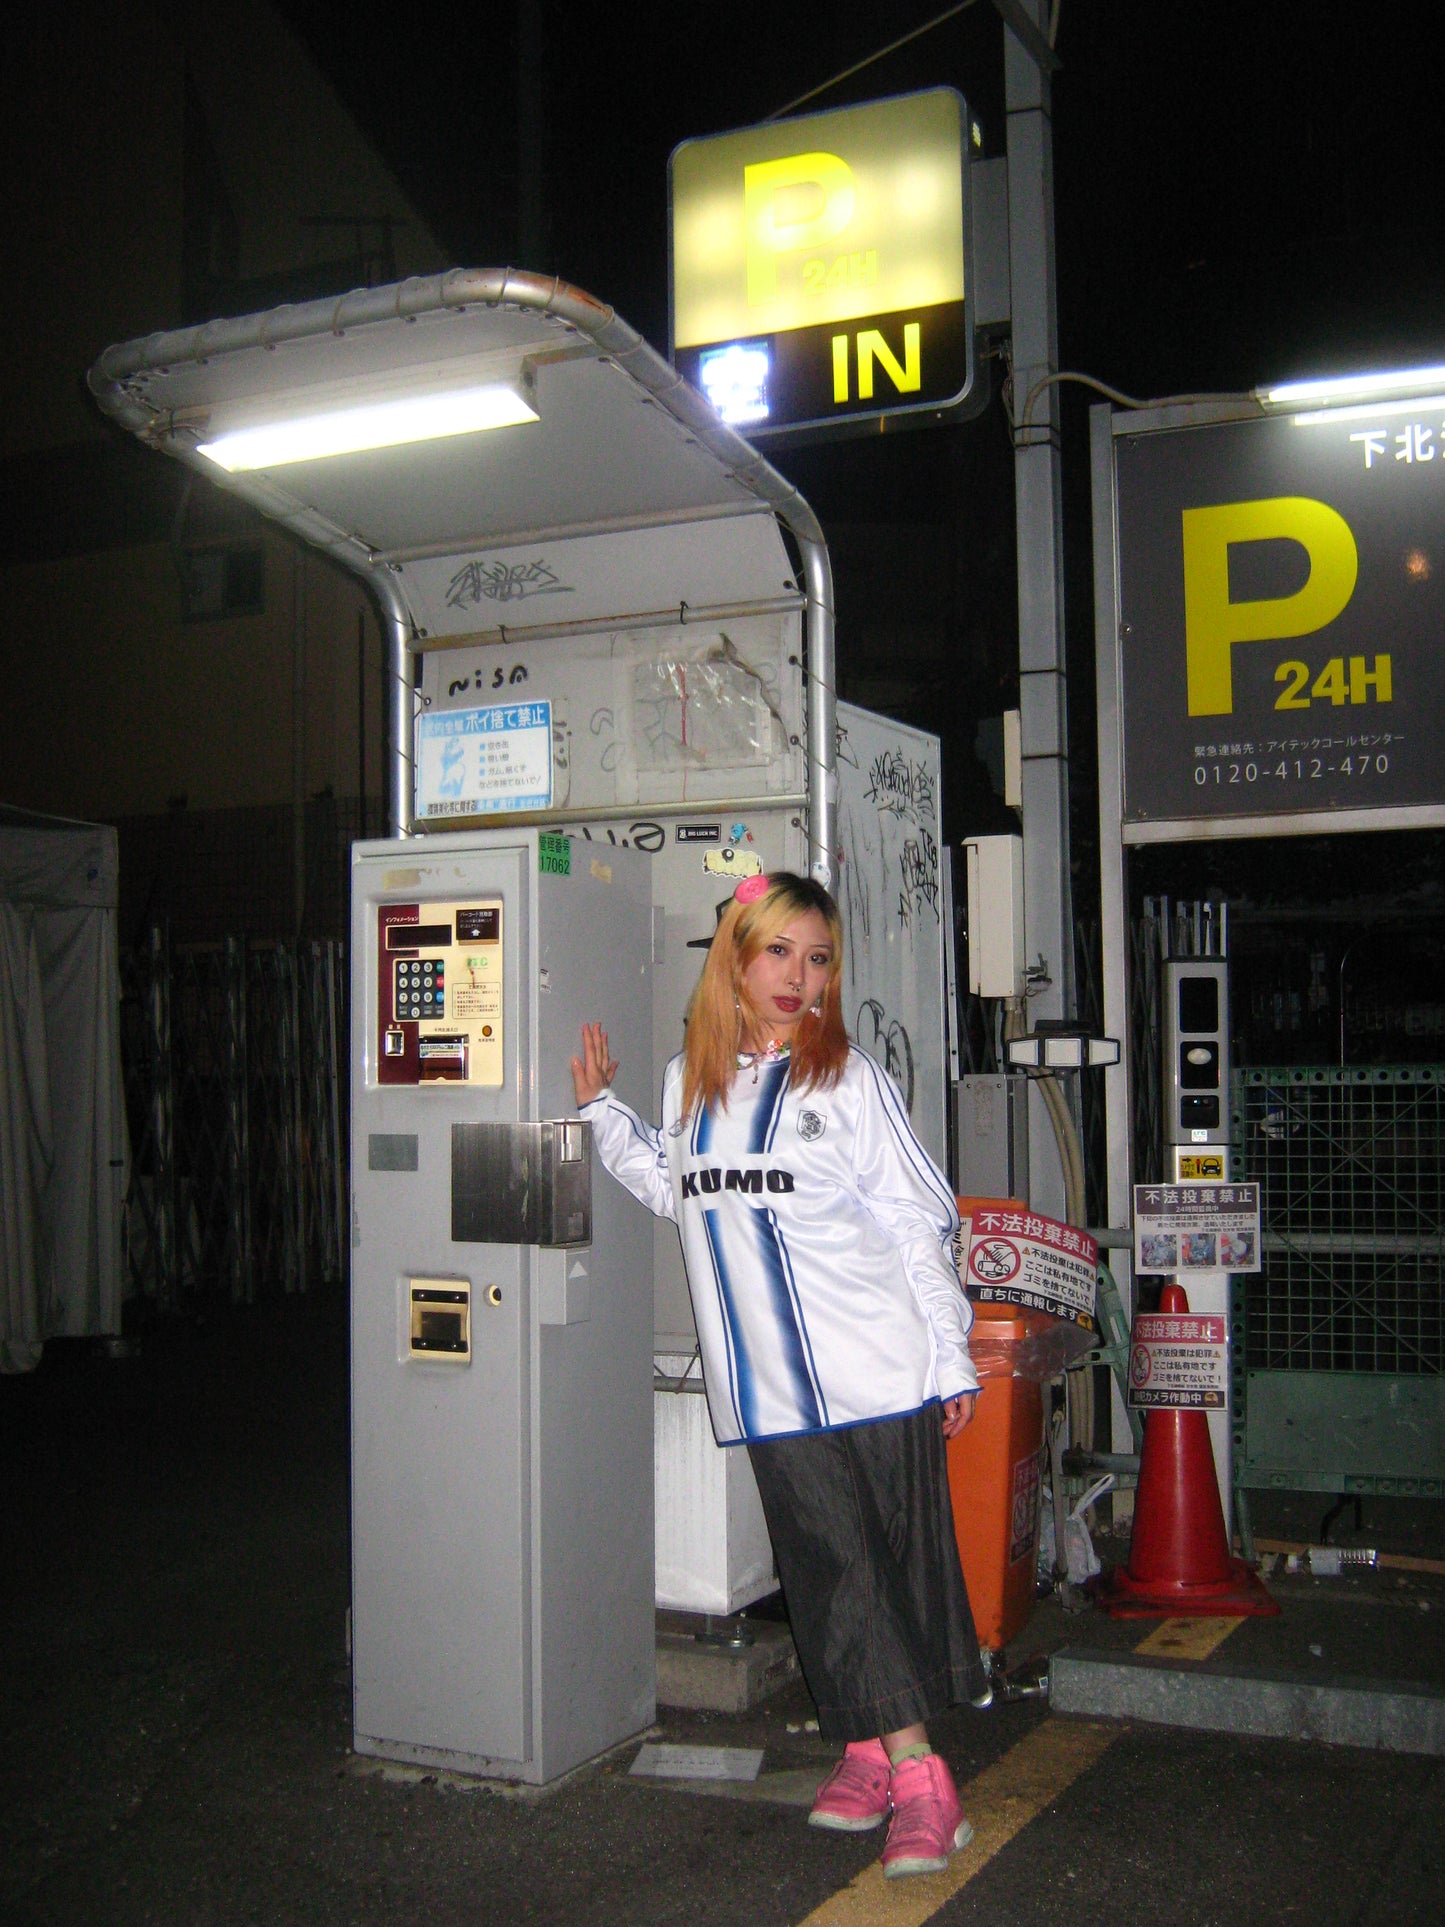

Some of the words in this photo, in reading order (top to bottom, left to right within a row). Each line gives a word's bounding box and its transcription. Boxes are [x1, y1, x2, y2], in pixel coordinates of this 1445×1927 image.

[744, 151, 857, 306] P
[803, 249, 879, 297] 24H
[832, 322, 921, 404] IN
[1349, 421, 1445, 469] 下北
[1182, 496, 1358, 716] P
[1274, 653, 1393, 710] 24H
[465, 705, 546, 731] ポイ捨て禁止
[1194, 754, 1389, 785] 0120-412-470
[540, 855, 570, 875] 17062
[681, 1168, 795, 1200] KUMO
[1145, 1188, 1252, 1205] 不法投棄禁止
[978, 1212, 1094, 1260] 不法投棄禁止
[1025, 1260, 1092, 1292] ここは私有地です
[1031, 1247, 1090, 1277] 不法投棄は犯罪
[980, 1287, 1078, 1321] 直ちに通報します
[1136, 1321, 1218, 1340] 不法投棄禁止
[1153, 1361, 1216, 1371] ここは私有地です
[1157, 1348, 1212, 1358] 不法投棄は犯罪
